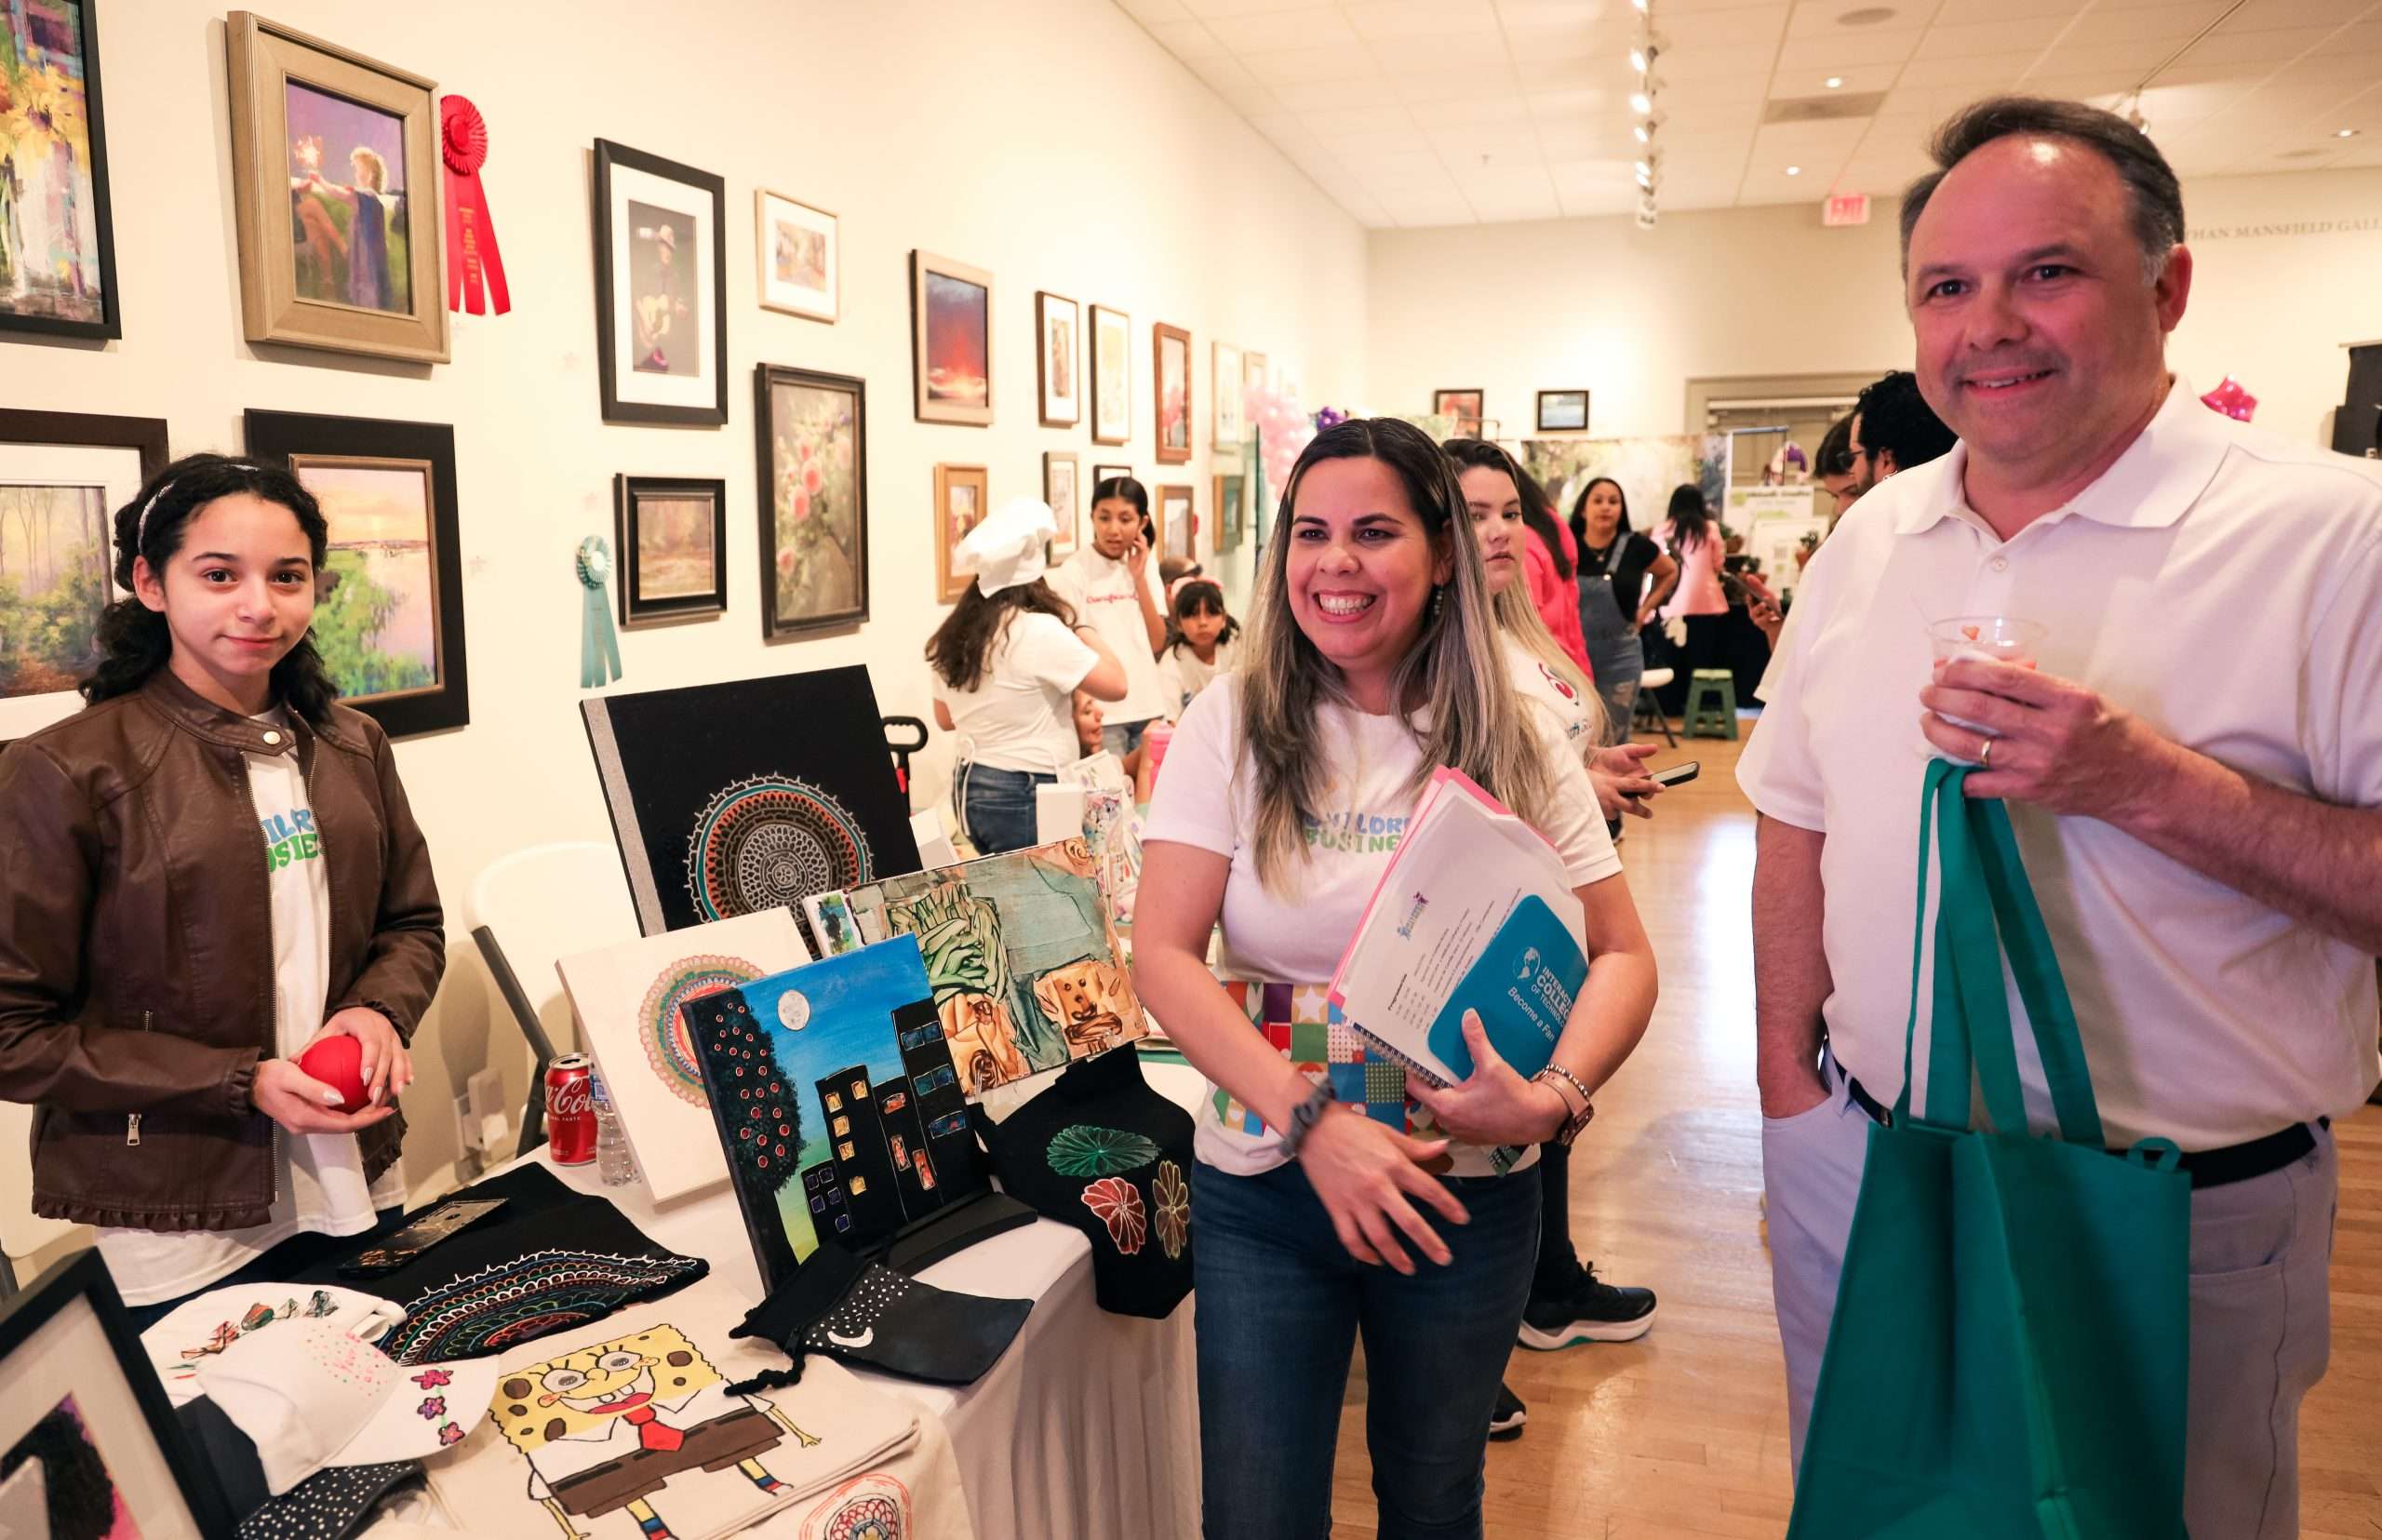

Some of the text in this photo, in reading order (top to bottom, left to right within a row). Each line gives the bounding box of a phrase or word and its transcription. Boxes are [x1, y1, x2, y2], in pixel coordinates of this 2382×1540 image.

[2233, 221, 2334, 238] MANSFIELD
[1531, 984, 1541, 996] OF
[1507, 986, 1555, 1042] Become a Fan
